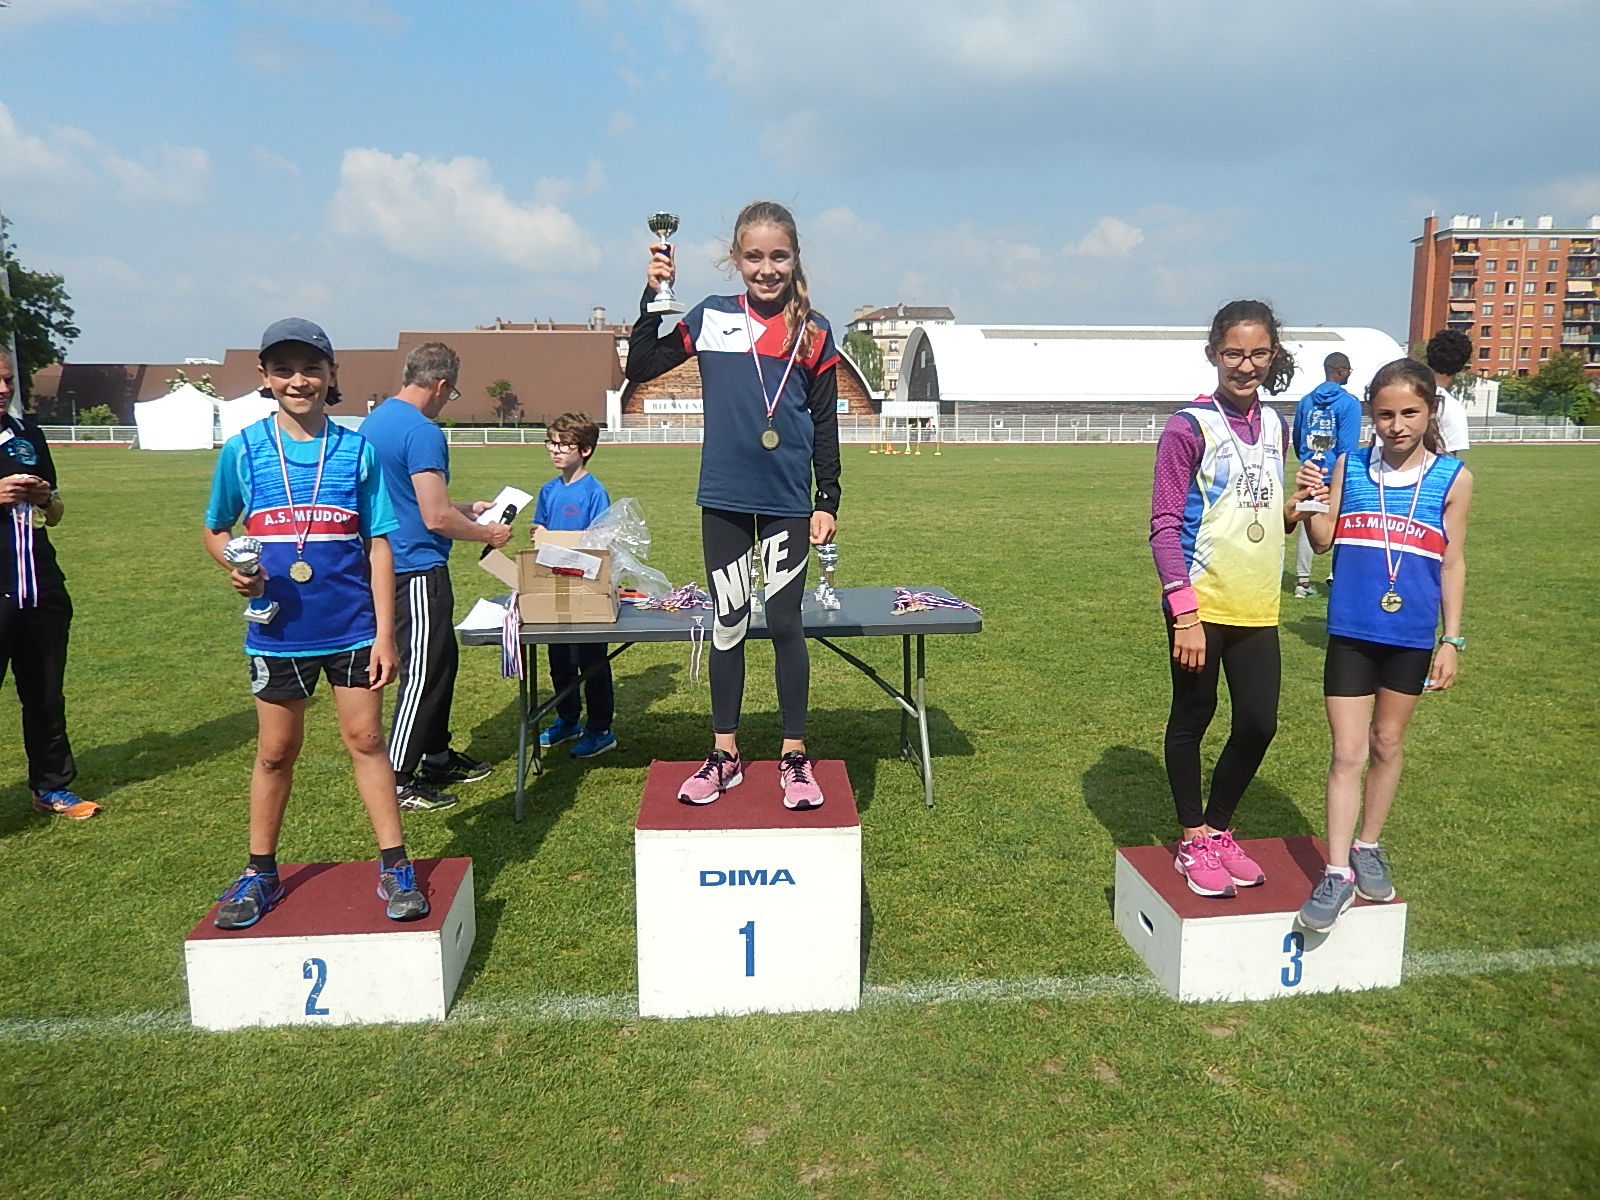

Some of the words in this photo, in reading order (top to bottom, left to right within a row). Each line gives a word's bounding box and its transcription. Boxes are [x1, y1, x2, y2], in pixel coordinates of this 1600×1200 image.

[264, 511, 291, 526] A.S.
[1343, 516, 1365, 529] A.S.
[699, 868, 797, 887] DIMA
[738, 920, 755, 977] 1
[1281, 930, 1305, 987] 3
[302, 957, 330, 1016] 2
